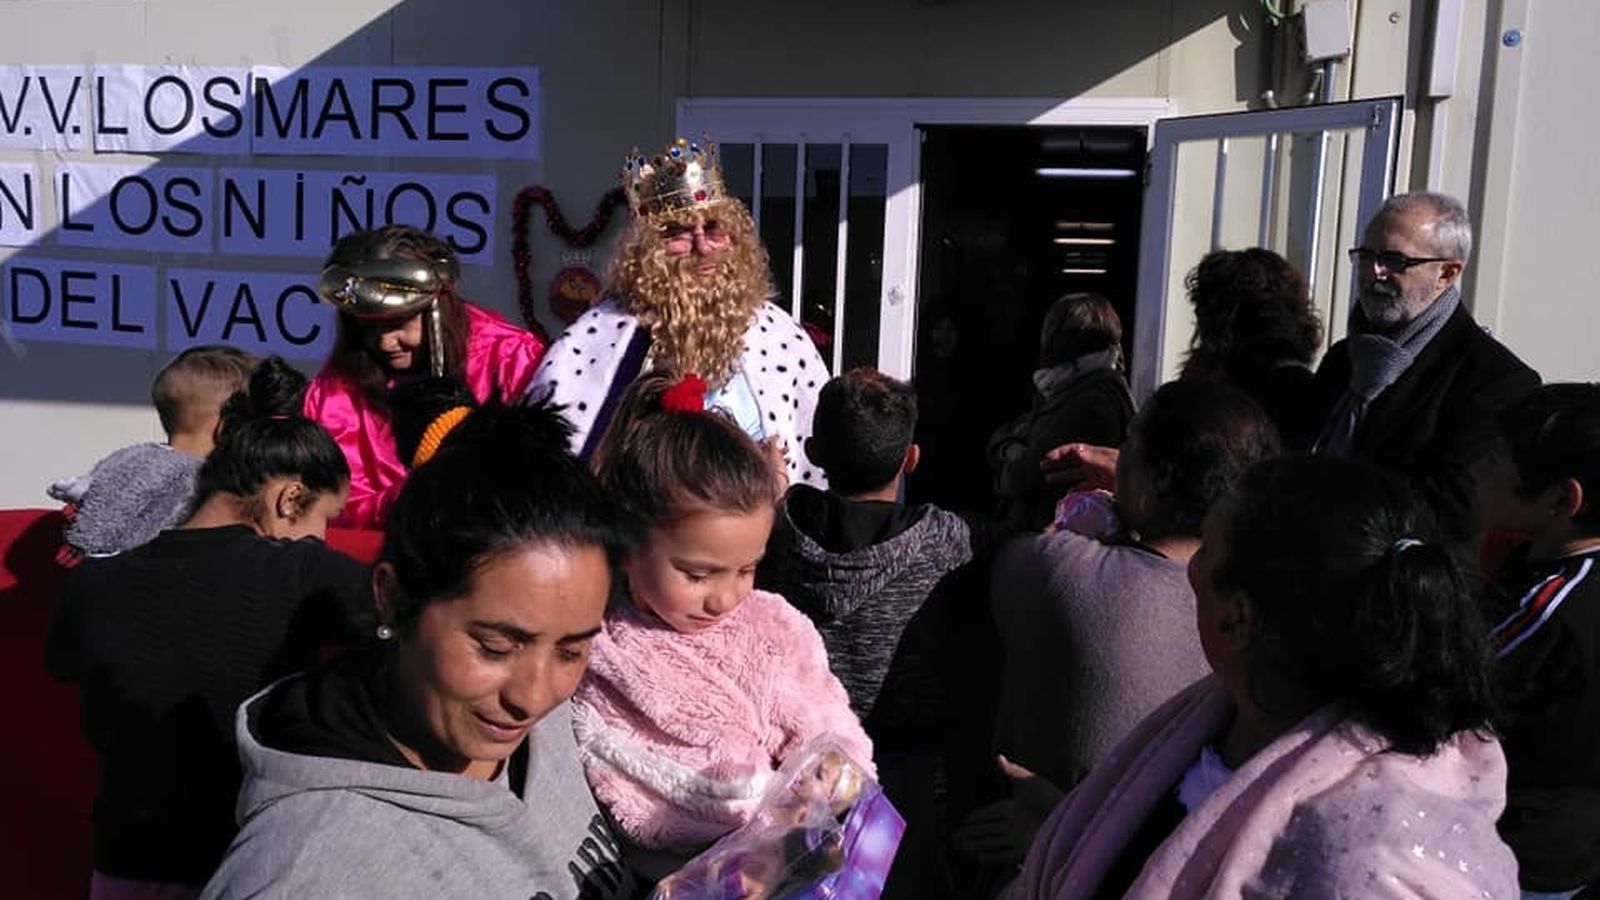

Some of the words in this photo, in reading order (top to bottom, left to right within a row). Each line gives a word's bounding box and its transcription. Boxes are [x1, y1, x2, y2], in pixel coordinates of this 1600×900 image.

[97, 76, 243, 138] LOS
[254, 78, 531, 142] MARES
[62, 173, 203, 237] LOS
[11, 266, 144, 333] DEL
